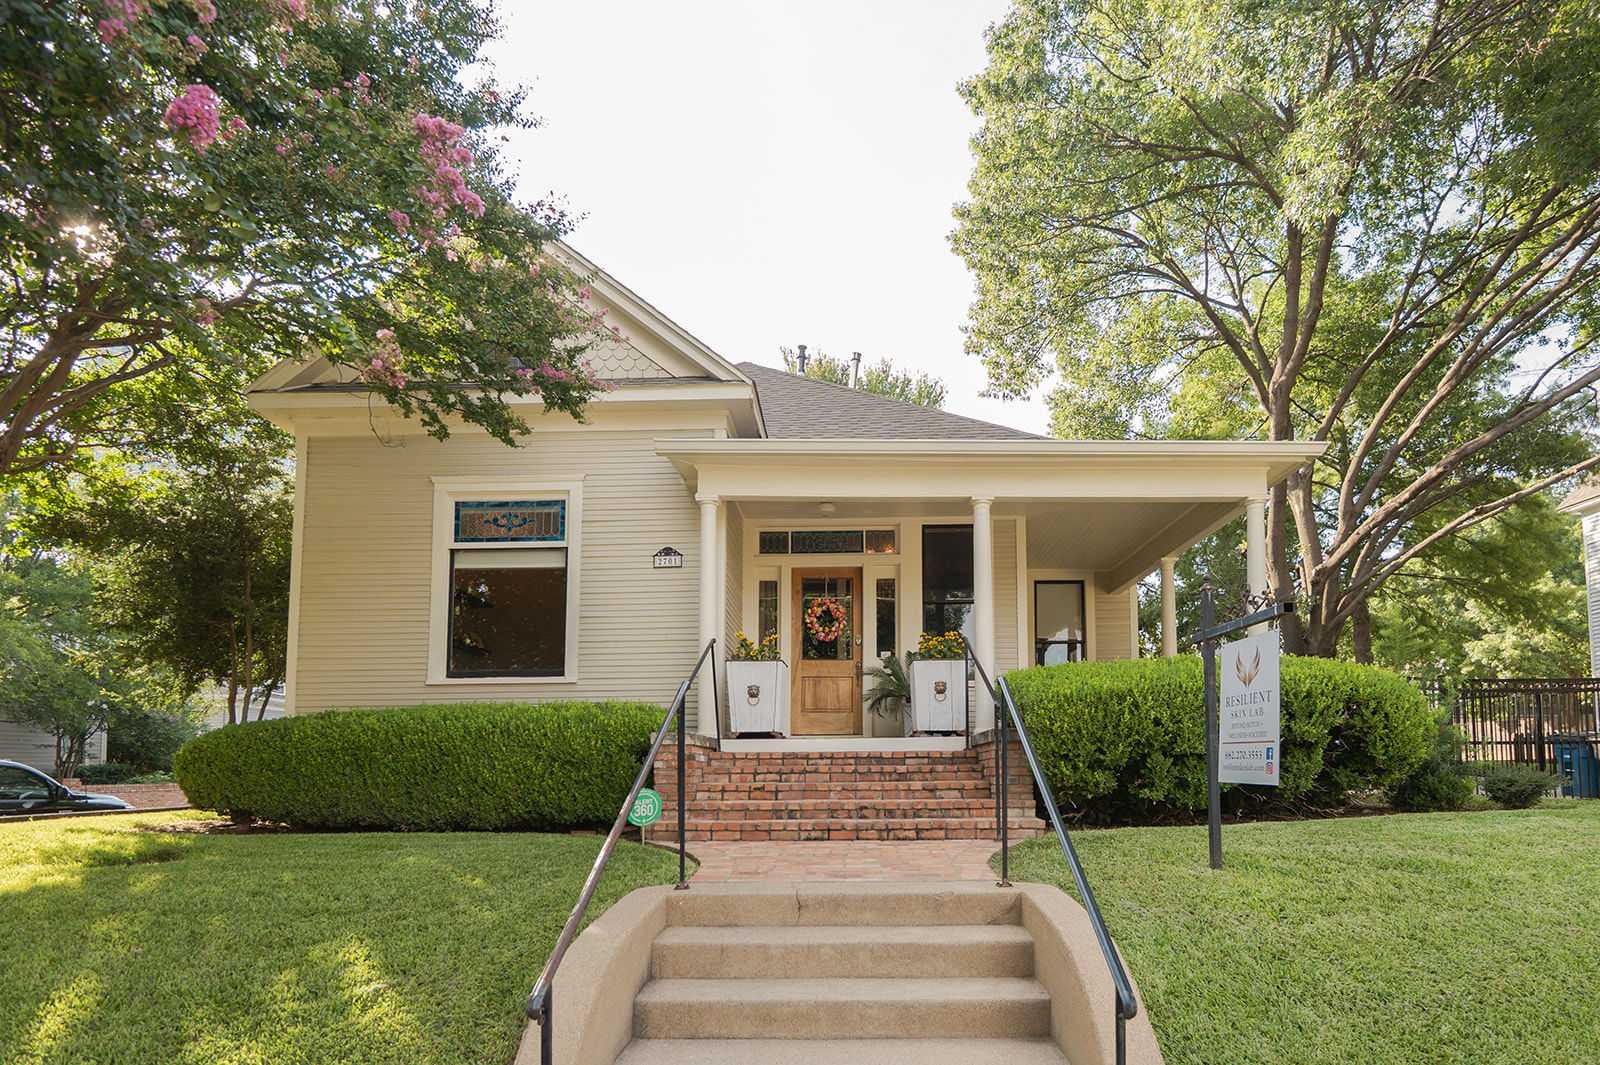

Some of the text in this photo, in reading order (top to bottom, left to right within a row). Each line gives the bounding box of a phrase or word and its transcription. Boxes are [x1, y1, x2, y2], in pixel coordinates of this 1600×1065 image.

[657, 557, 678, 566] 2701
[1225, 690, 1273, 708] RESILIENT
[1230, 706, 1264, 719] SKIN LAB
[633, 804, 654, 817] 360
